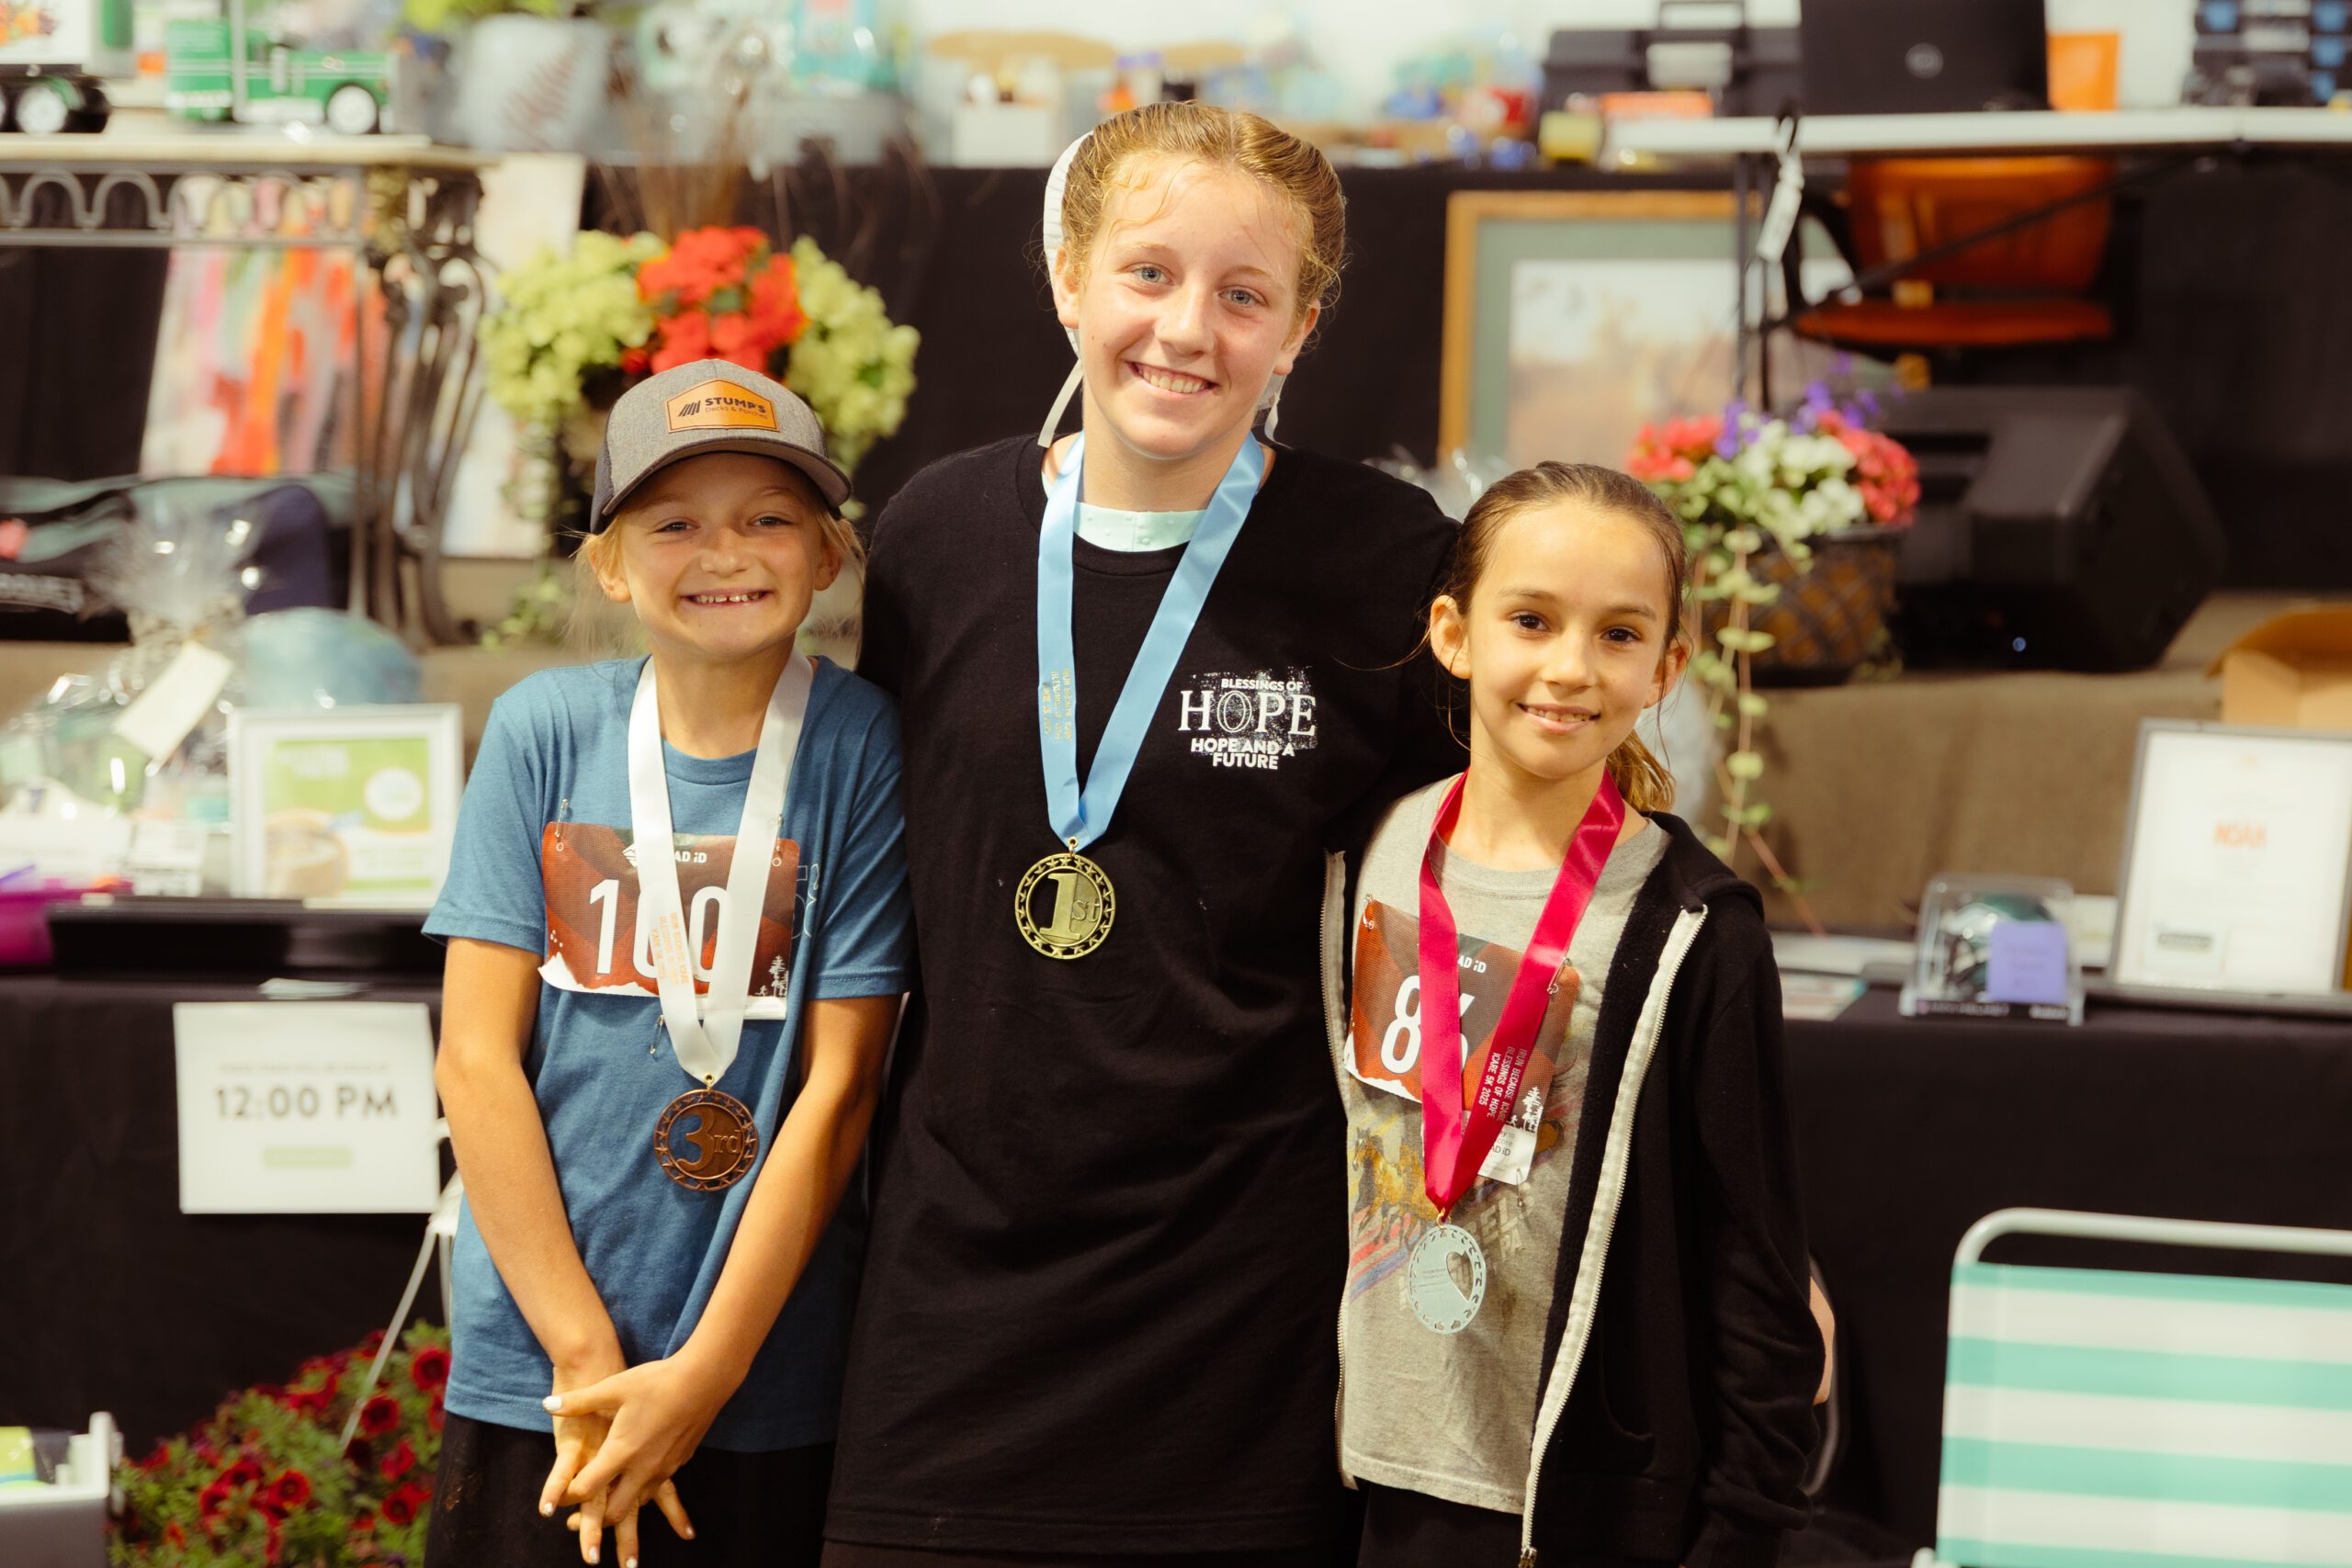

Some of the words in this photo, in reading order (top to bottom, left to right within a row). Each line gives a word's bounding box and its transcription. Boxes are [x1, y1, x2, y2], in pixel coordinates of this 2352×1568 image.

[705, 397, 766, 413] STUMP'S
[1221, 678, 1284, 691] BLESSINGS
[1286, 681, 1304, 691] OF
[1178, 690, 1317, 736] HOPE
[1191, 738, 1237, 752] HOPE
[1241, 739, 1280, 754] AND
[1282, 742, 1295, 757] A
[1213, 752, 1279, 770] FUTURE
[674, 851, 691, 863] AD
[1457, 954, 1471, 970] AD
[1487, 1052, 1501, 1074] ICARE
[1497, 1046, 1515, 1085] BLESSINGS
[1485, 1075, 1495, 1086] 5K
[1504, 1067, 1521, 1100] BECAUSE
[1478, 1087, 1491, 1106] 2025
[1494, 1086, 1503, 1097] OF
[216, 1086, 321, 1118] 12:00
[336, 1086, 398, 1118] PM
[1487, 1098, 1499, 1118] HOPE
